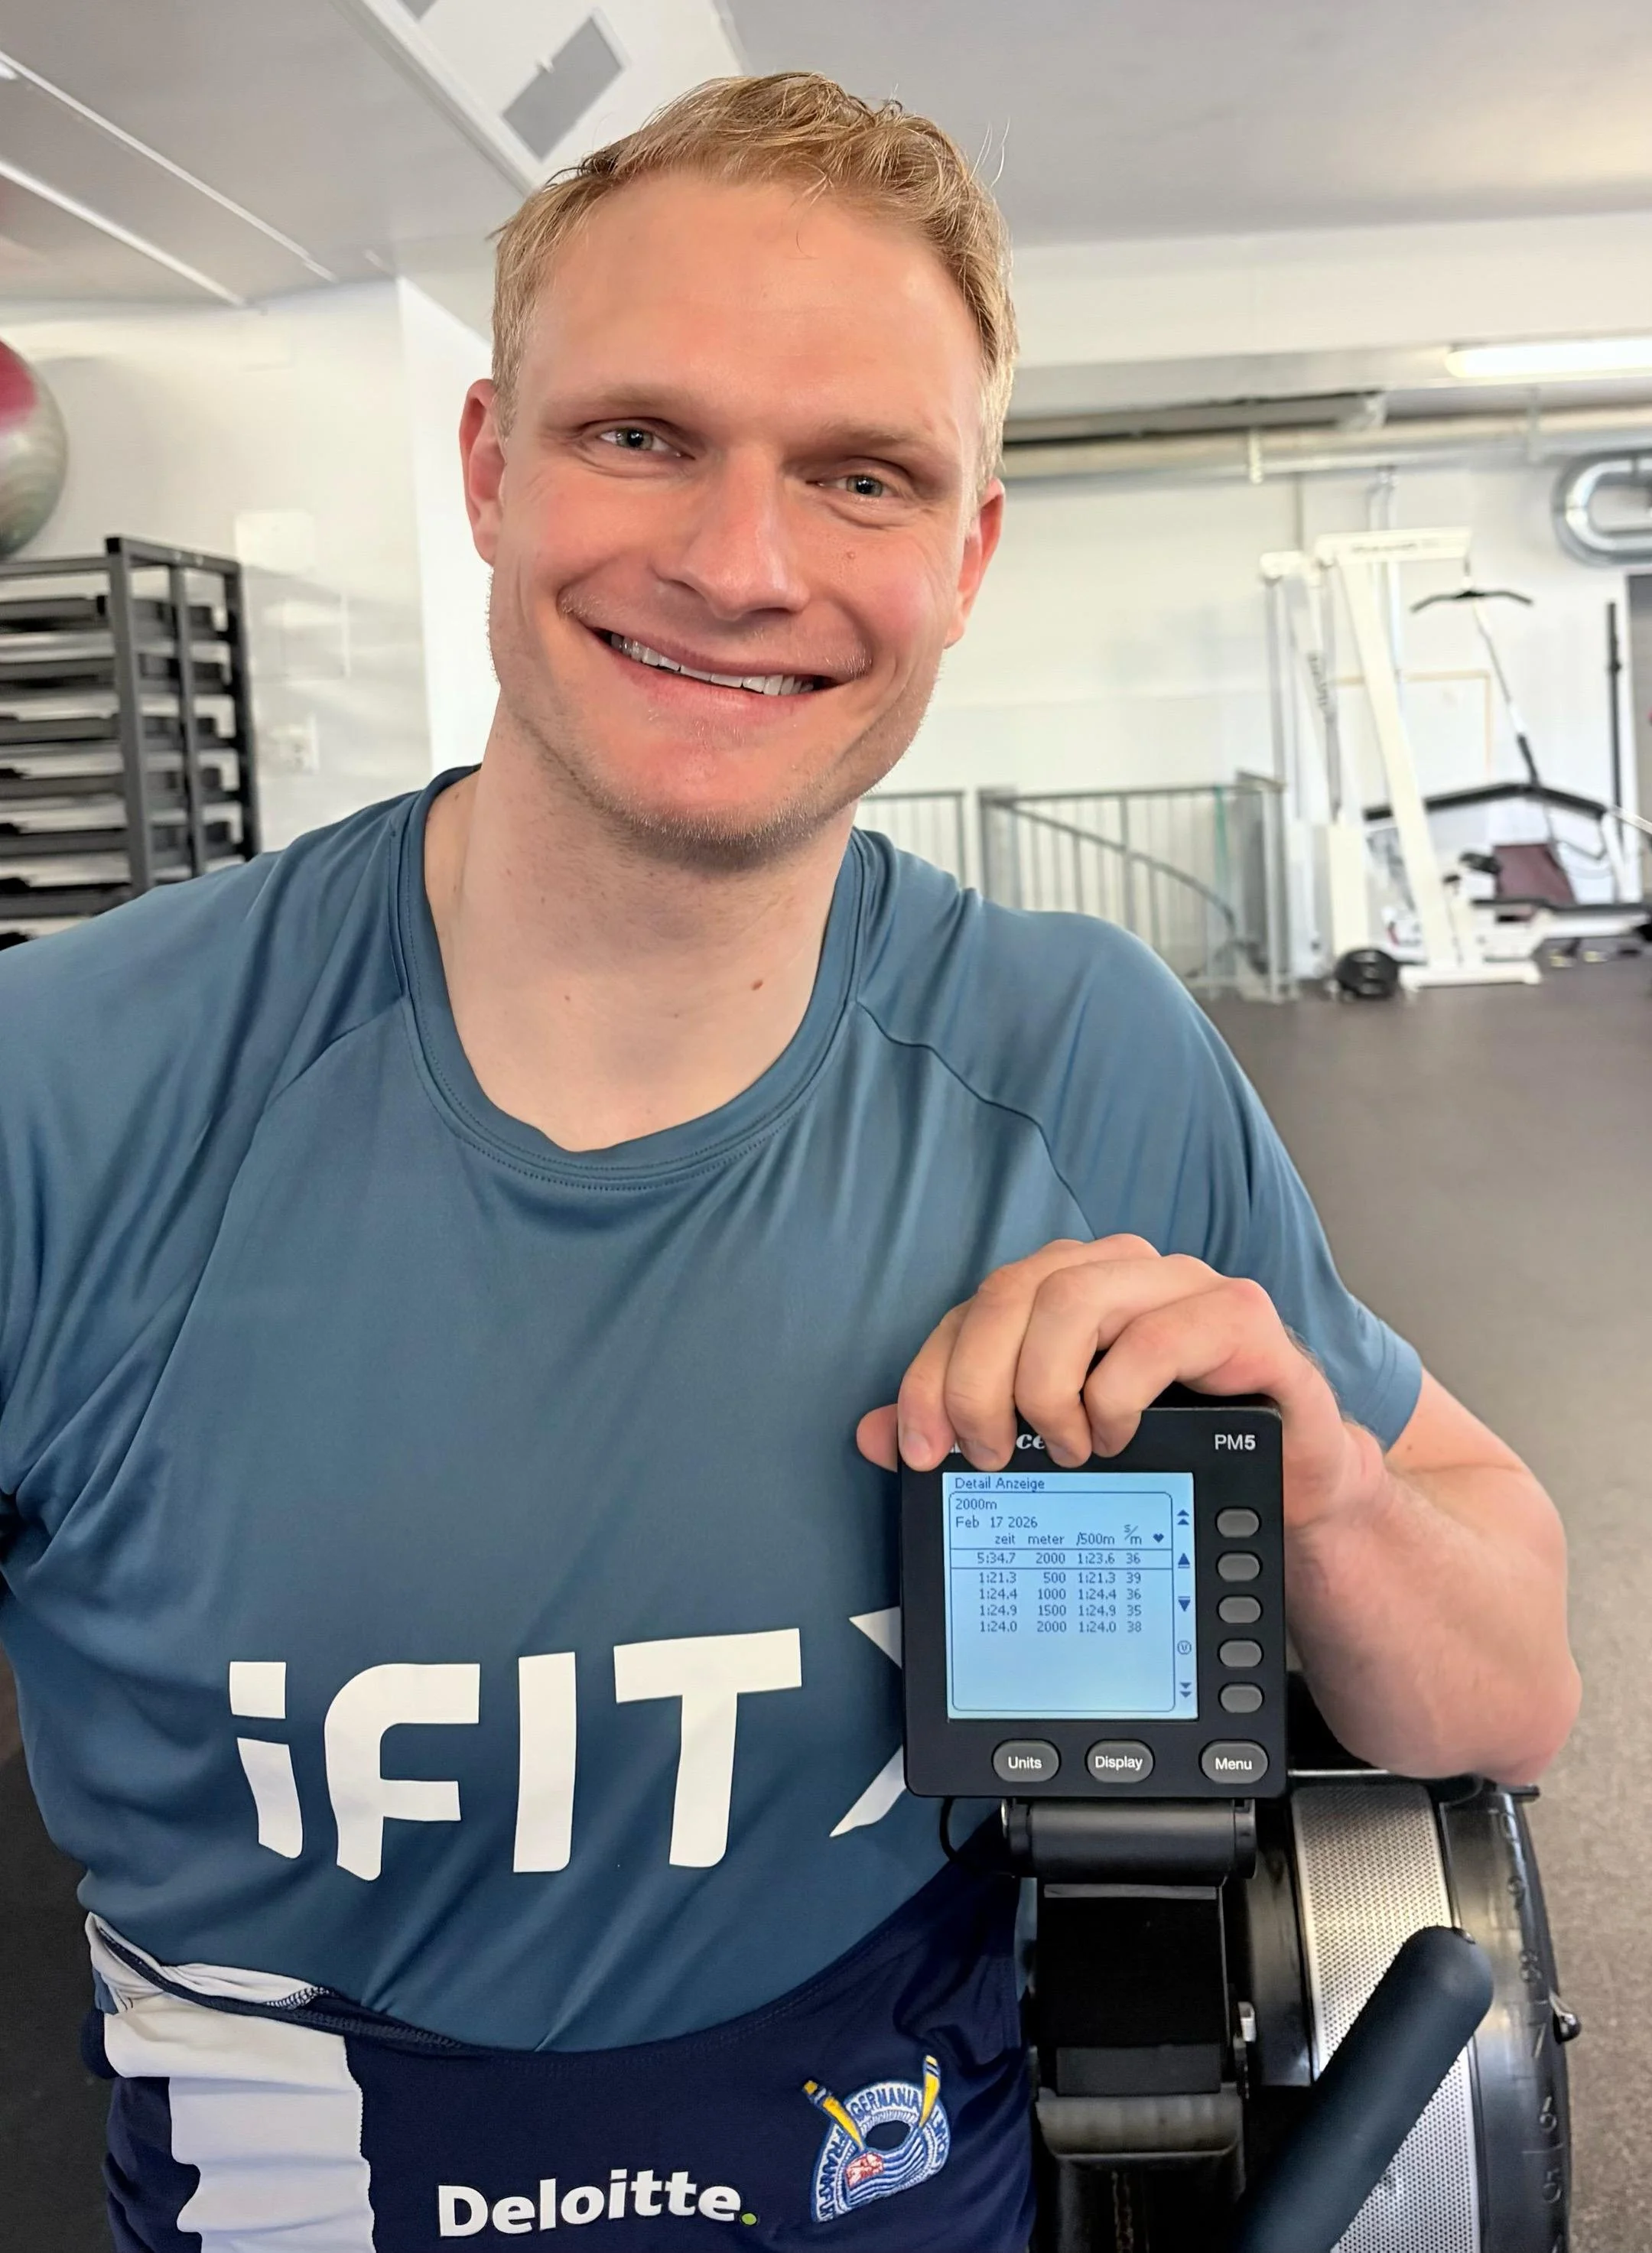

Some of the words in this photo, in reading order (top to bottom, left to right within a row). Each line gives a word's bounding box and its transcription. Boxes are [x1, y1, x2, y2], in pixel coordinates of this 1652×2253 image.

[1215, 1434, 1256, 1451] PM5
[955, 1476, 990, 1489] Detail
[996, 1478, 1045, 1491] Anzeige
[955, 1498, 997, 1510] 2000m
[956, 1515, 979, 1528] Feb
[991, 1517, 1003, 1528] 17
[1008, 1517, 1038, 1529] 2026
[995, 1533, 1015, 1544] zeit
[1028, 1535, 1065, 1544] meter
[977, 1552, 1016, 1564] 5:34.7
[1036, 1552, 1065, 1564] 2000
[1078, 1552, 1115, 1564] 1:23.6
[1127, 1552, 1140, 1564] 36
[980, 1572, 1016, 1584] 1:21.3
[1043, 1572, 1066, 1584] 500
[1078, 1572, 1115, 1584] 1:21.3
[1127, 1572, 1141, 1584] 39
[980, 1588, 1017, 1600] 1:24.4
[1039, 1588, 1066, 1600] 1000
[1079, 1588, 1117, 1600] 1:24.4
[1127, 1588, 1141, 1600] 36
[980, 1604, 1016, 1616] 1:24.9
[1039, 1604, 1066, 1616] 1500
[1079, 1604, 1116, 1617] 1:24.9
[1127, 1604, 1141, 1616] 35
[980, 1621, 1017, 1632] 1:24.0
[1037, 1621, 1066, 1632] 2000
[1080, 1621, 1116, 1633] 1:24.0
[1127, 1621, 1141, 1633] 38
[229, 1628, 802, 1881] iFIT
[1008, 1757, 1042, 1769] Units
[1094, 1756, 1143, 1770] Display
[1215, 1757, 1253, 1770] Menu
[850, 2086, 922, 2118] GERMANIA
[1539, 2095, 1558, 2134] 6
[1543, 2167, 1562, 2204] 5
